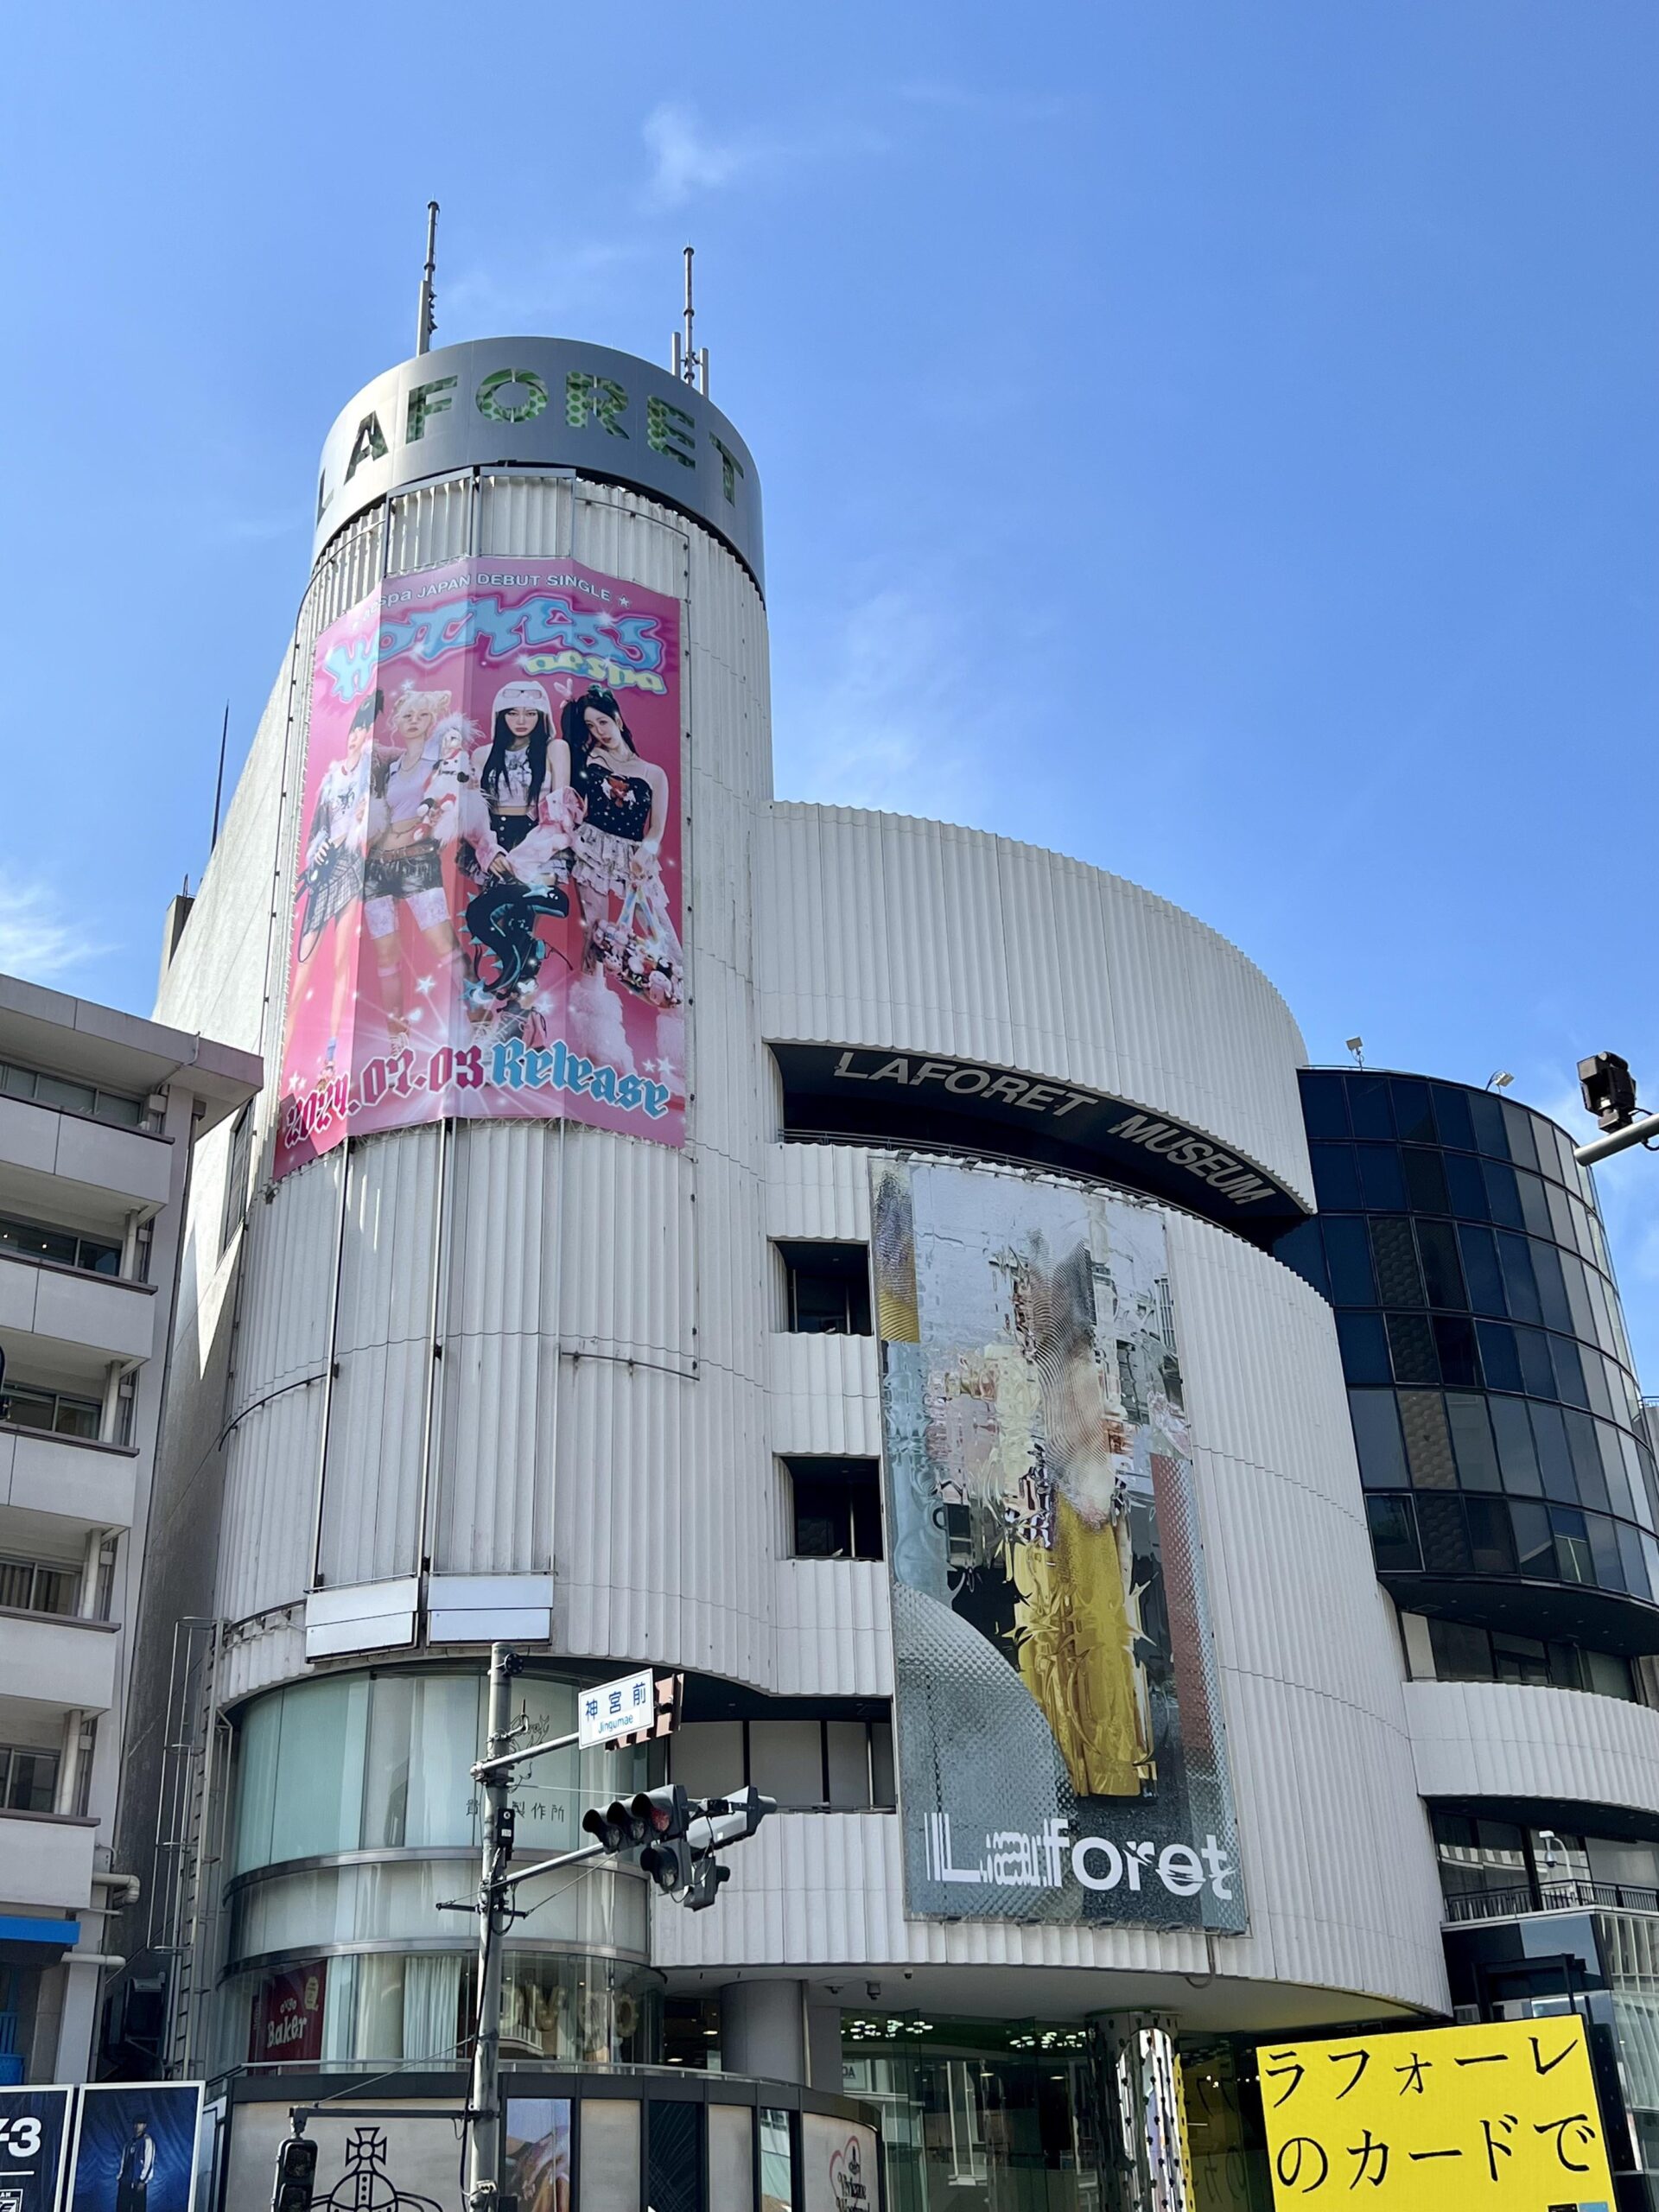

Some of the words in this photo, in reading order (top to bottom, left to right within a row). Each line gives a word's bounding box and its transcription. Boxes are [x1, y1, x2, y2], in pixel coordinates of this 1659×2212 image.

[416, 574, 472, 599] JAPAN
[476, 573, 542, 587] DEBUT
[546, 575, 611, 602] SINGLE
[491, 1036, 671, 1120] Release
[833, 1051, 1098, 1118] LAFORET
[1106, 1113, 1276, 1205] MUSEUM
[585, 1681, 646, 1722] 神宮前
[598, 1714, 633, 1734] Jingumae
[924, 1812, 1237, 1900] Laforet
[1265, 2036, 1579, 2108] ラフォーレ
[1276, 2113, 1597, 2194] のカードで
